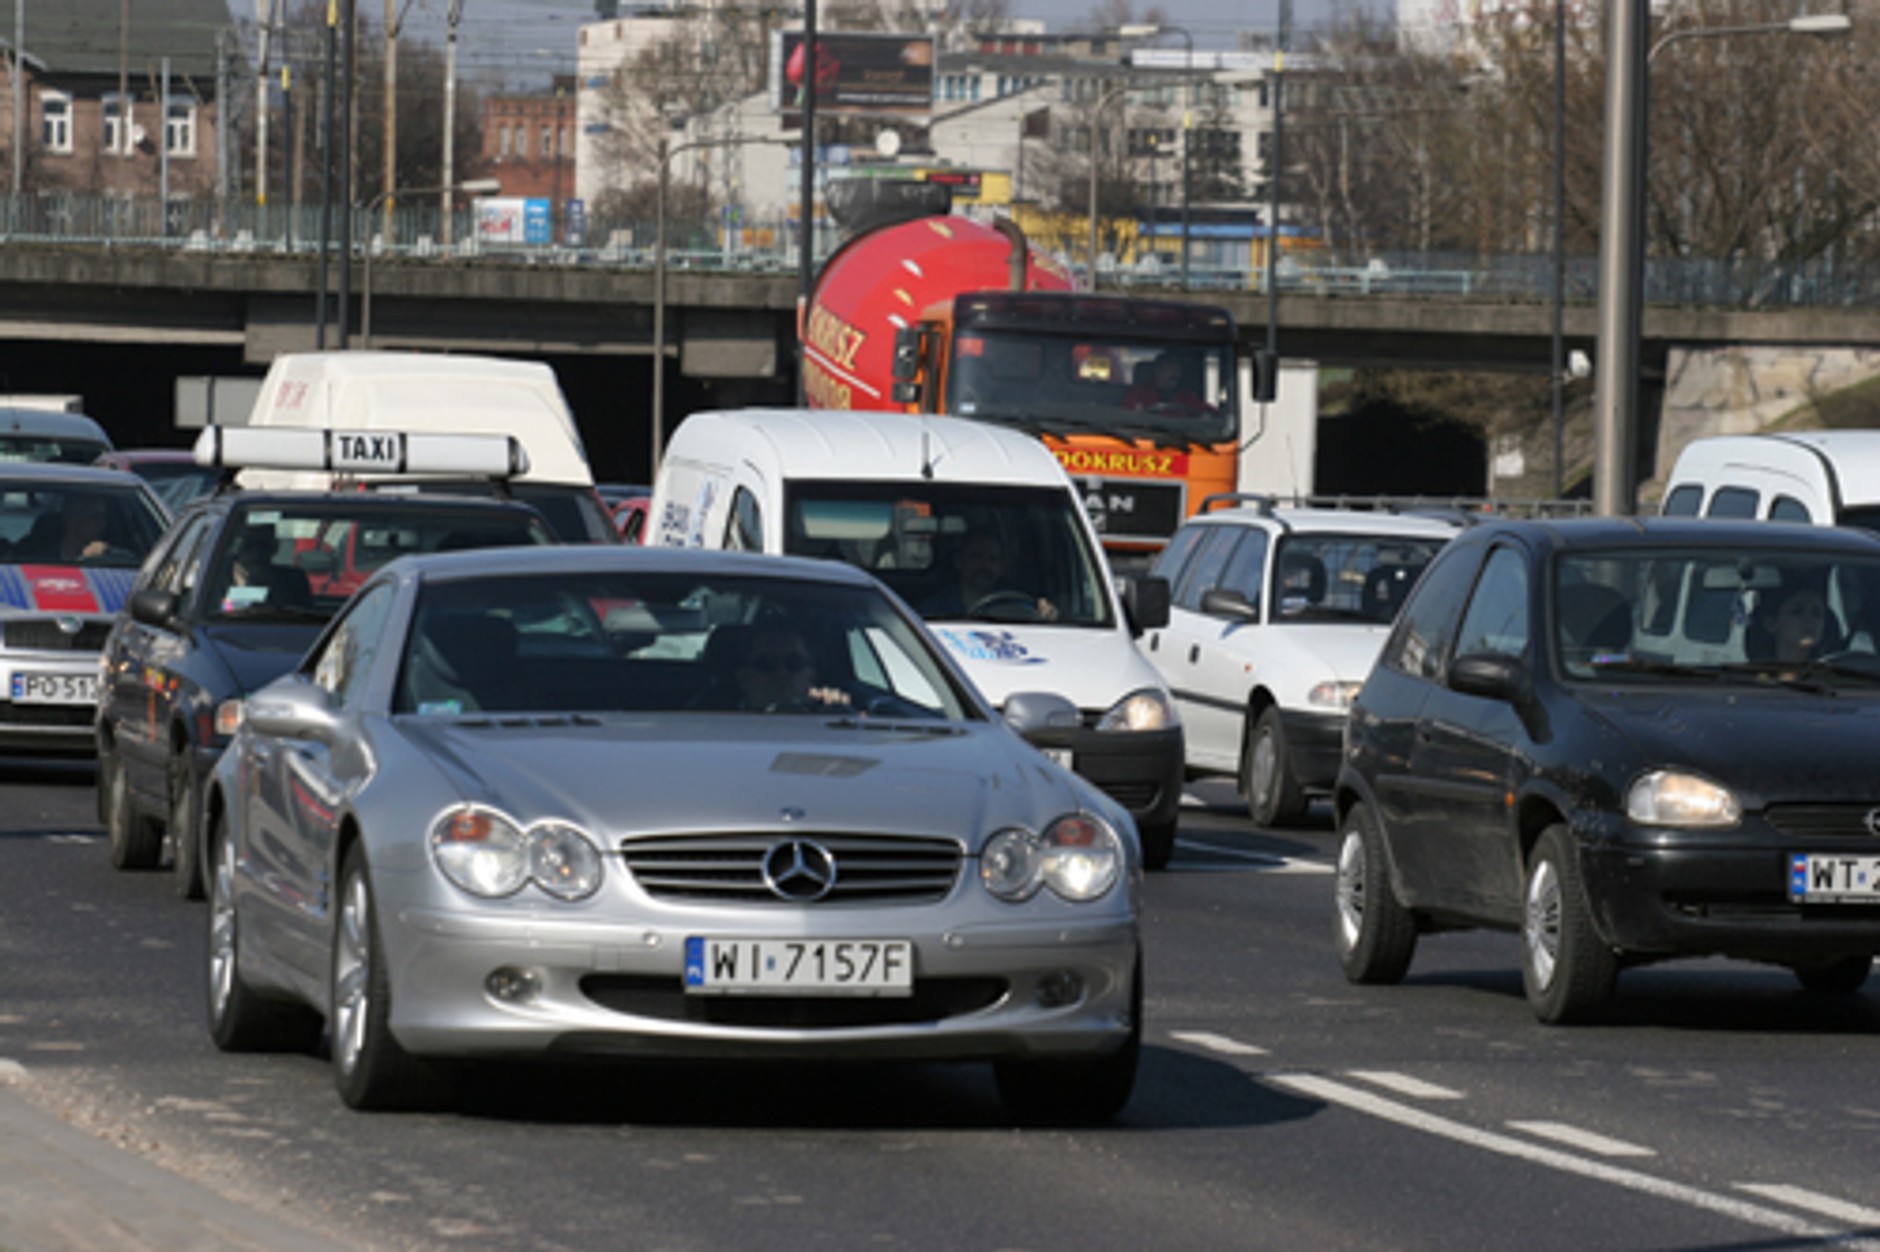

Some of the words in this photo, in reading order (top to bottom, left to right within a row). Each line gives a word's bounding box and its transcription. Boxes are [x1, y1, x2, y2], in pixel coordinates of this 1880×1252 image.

[339, 436, 394, 460] TAXI
[1085, 493, 1134, 512] AN
[1812, 861, 1858, 889] WT
[713, 943, 760, 980] WI
[785, 944, 906, 982] 7157F
